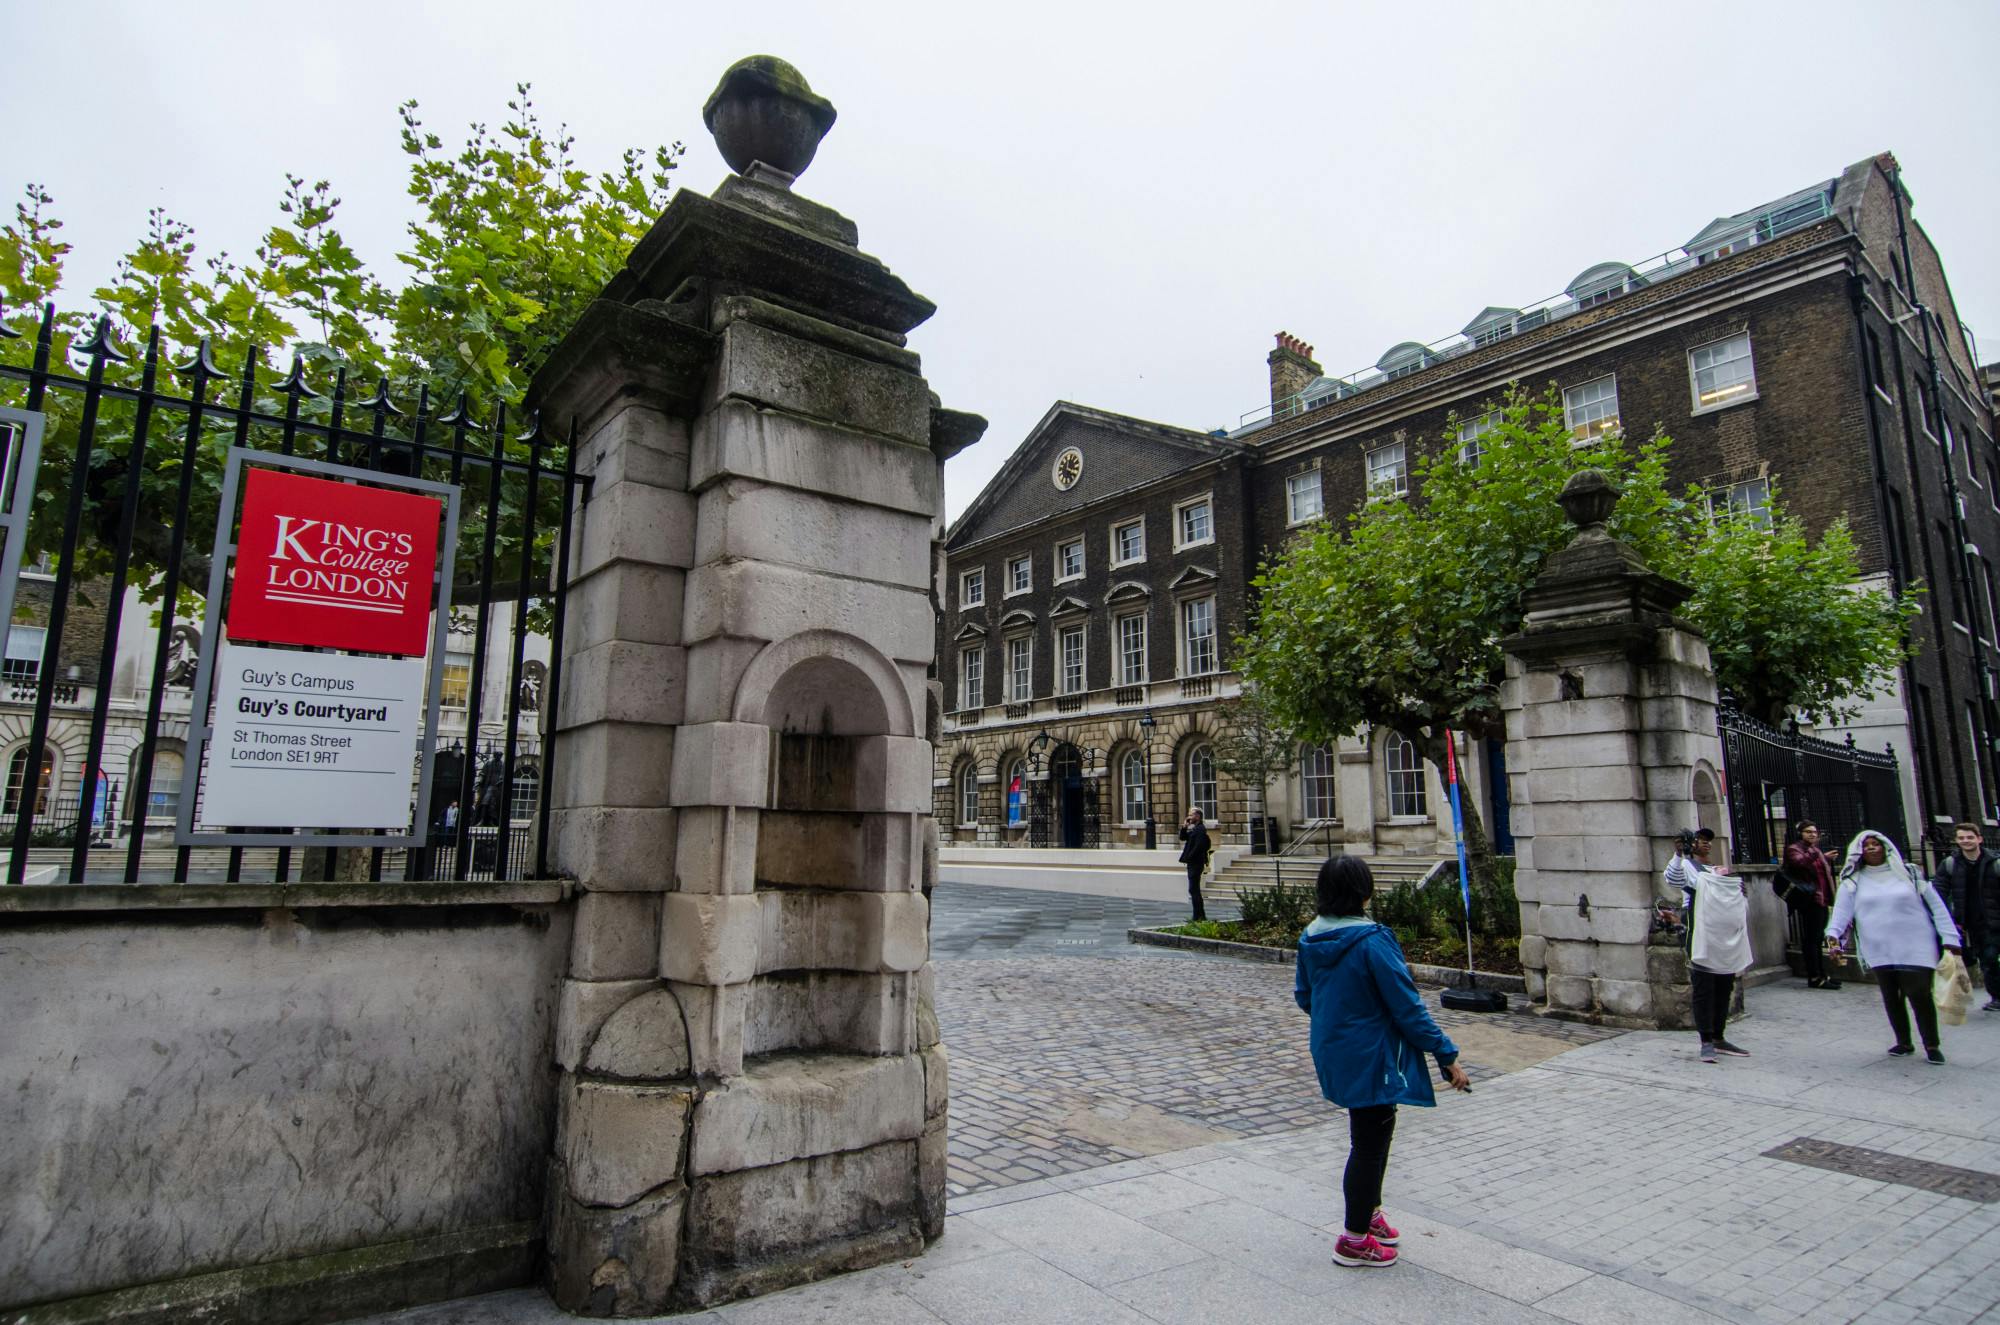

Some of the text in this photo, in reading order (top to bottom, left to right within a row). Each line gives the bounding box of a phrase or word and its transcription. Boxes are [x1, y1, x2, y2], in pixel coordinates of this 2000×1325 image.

[269, 514, 413, 564] KING'S
[319, 546, 409, 578] College
[268, 564, 409, 600] LONDON
[241, 668, 355, 692] Guy's Campus
[237, 696, 388, 722] Guy's Courtyard
[233, 729, 352, 748] St Thomas Street
[231, 747, 340, 764] London SE1 9RT
